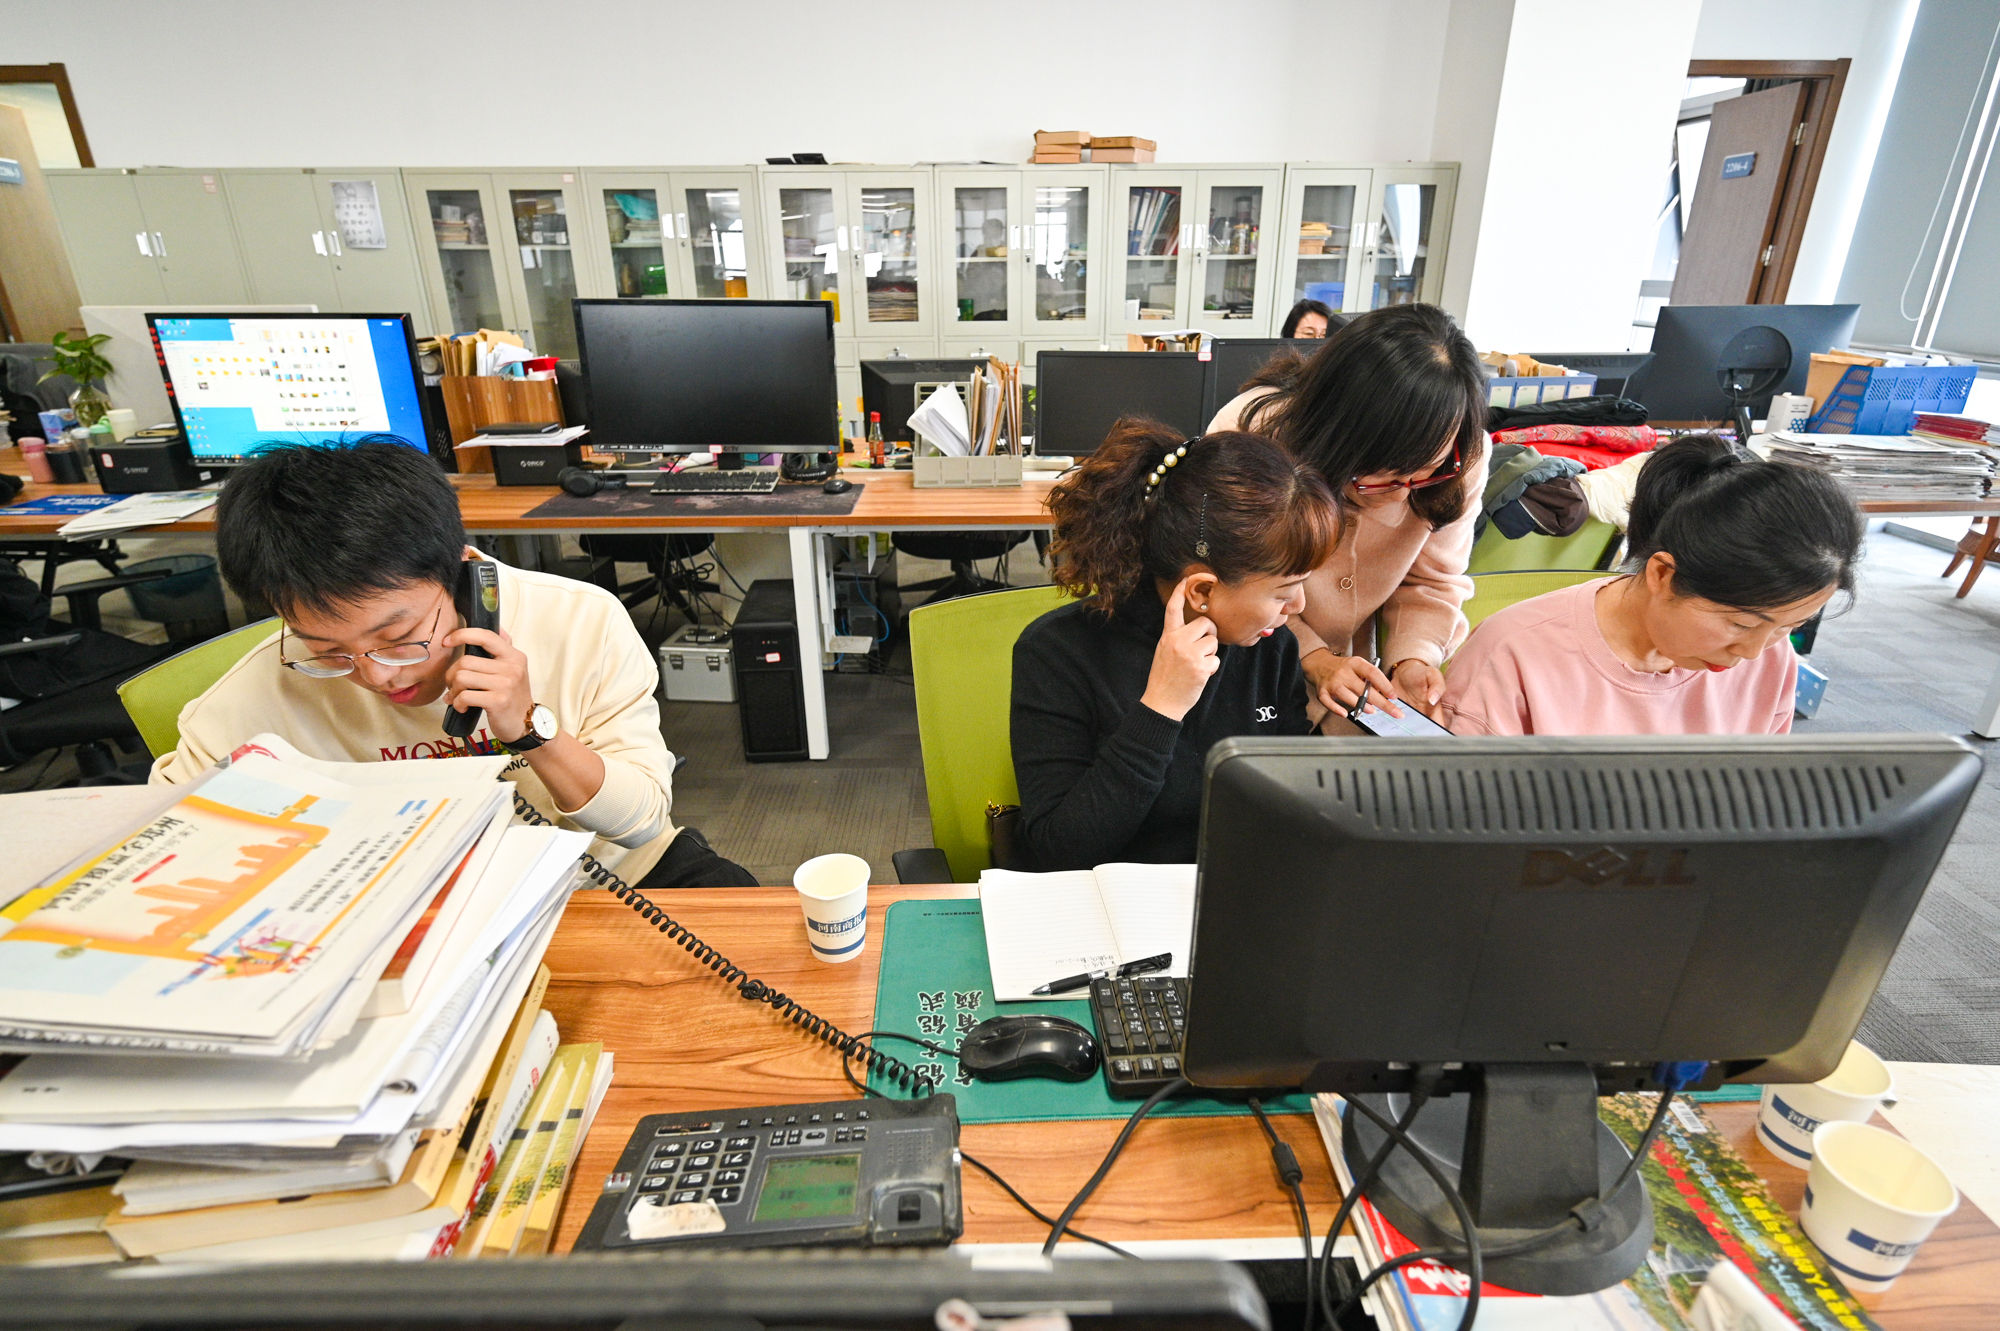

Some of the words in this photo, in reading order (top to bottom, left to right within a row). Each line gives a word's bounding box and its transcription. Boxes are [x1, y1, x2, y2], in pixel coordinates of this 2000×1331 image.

[1521, 845, 1696, 887] DELL
[817, 913, 863, 933] 河南商报
[914, 991, 948, 1087] 能文能武
[953, 989, 983, 1087] 有有颜
